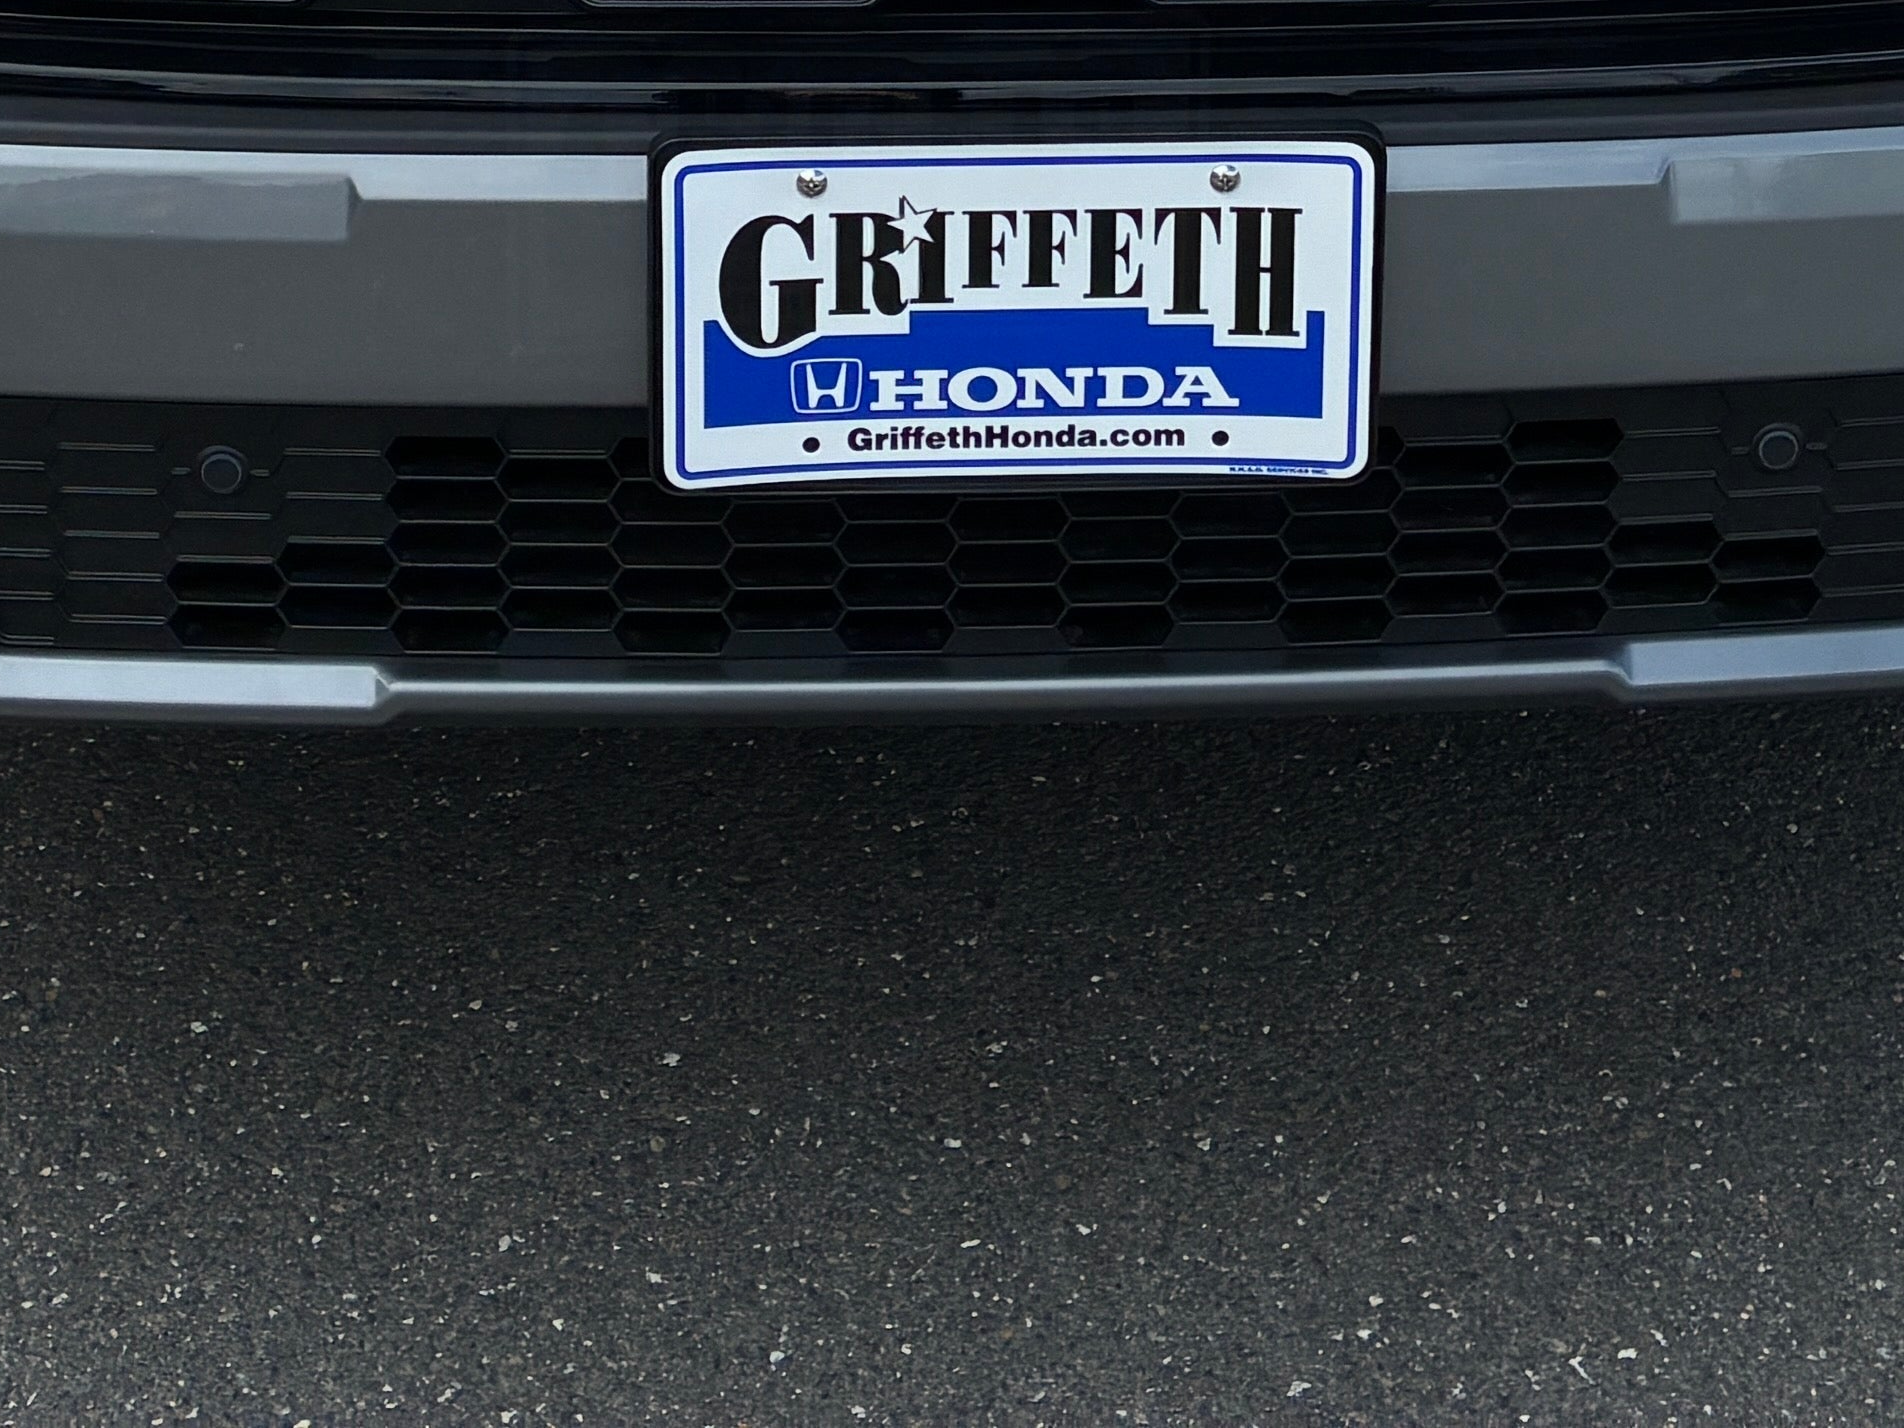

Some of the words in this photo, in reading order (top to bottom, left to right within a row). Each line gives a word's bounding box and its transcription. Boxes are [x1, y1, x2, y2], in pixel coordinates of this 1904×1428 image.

[718, 207, 1302, 349] GRIFFETH
[869, 366, 1240, 411] HONDA
[847, 424, 1185, 452] GriffethHonda.com
